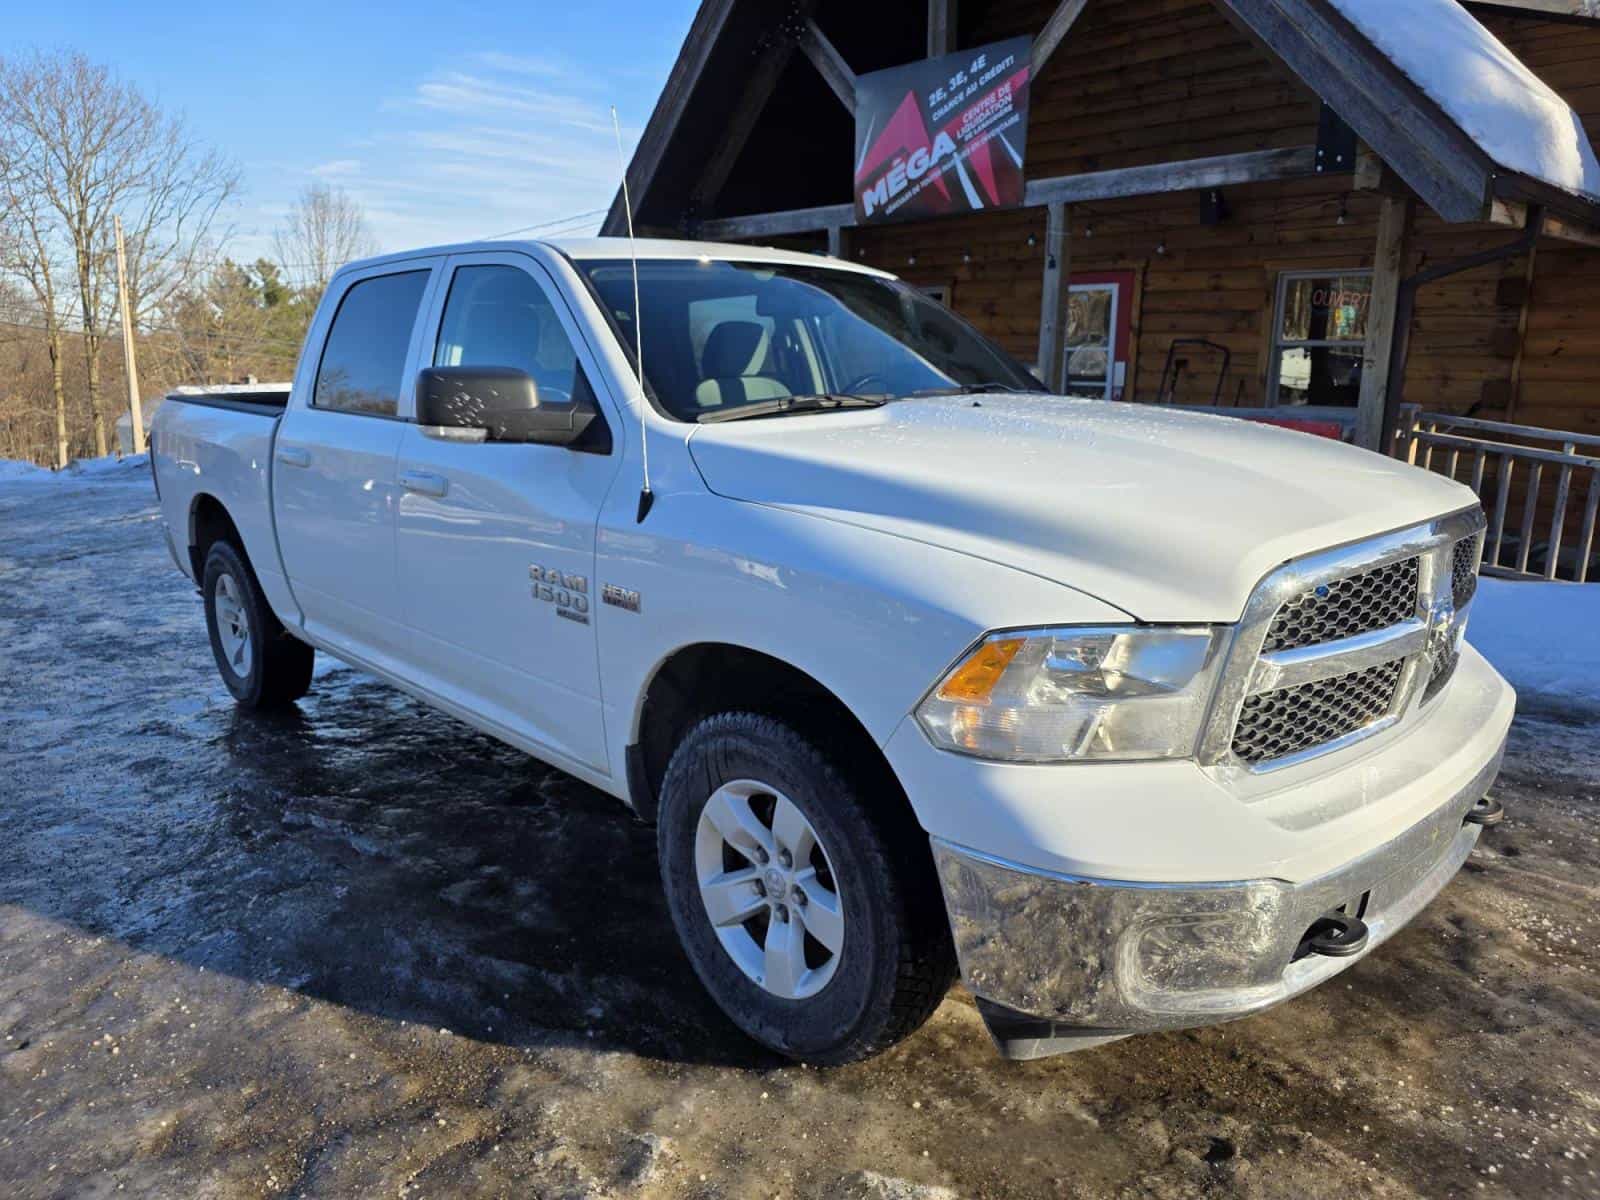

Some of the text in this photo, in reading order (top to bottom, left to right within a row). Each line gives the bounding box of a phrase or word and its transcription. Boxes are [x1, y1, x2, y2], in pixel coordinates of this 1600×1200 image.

[970, 54, 987, 73] 4E
[932, 93, 965, 122] CHANCE
[966, 81, 978, 98] AU
[956, 93, 1013, 140] LIQUIDATION
[962, 81, 1012, 124] CENTRE DE
[862, 130, 957, 217] MÉGA
[528, 562, 588, 594] RAM
[531, 583, 589, 614] 1500
